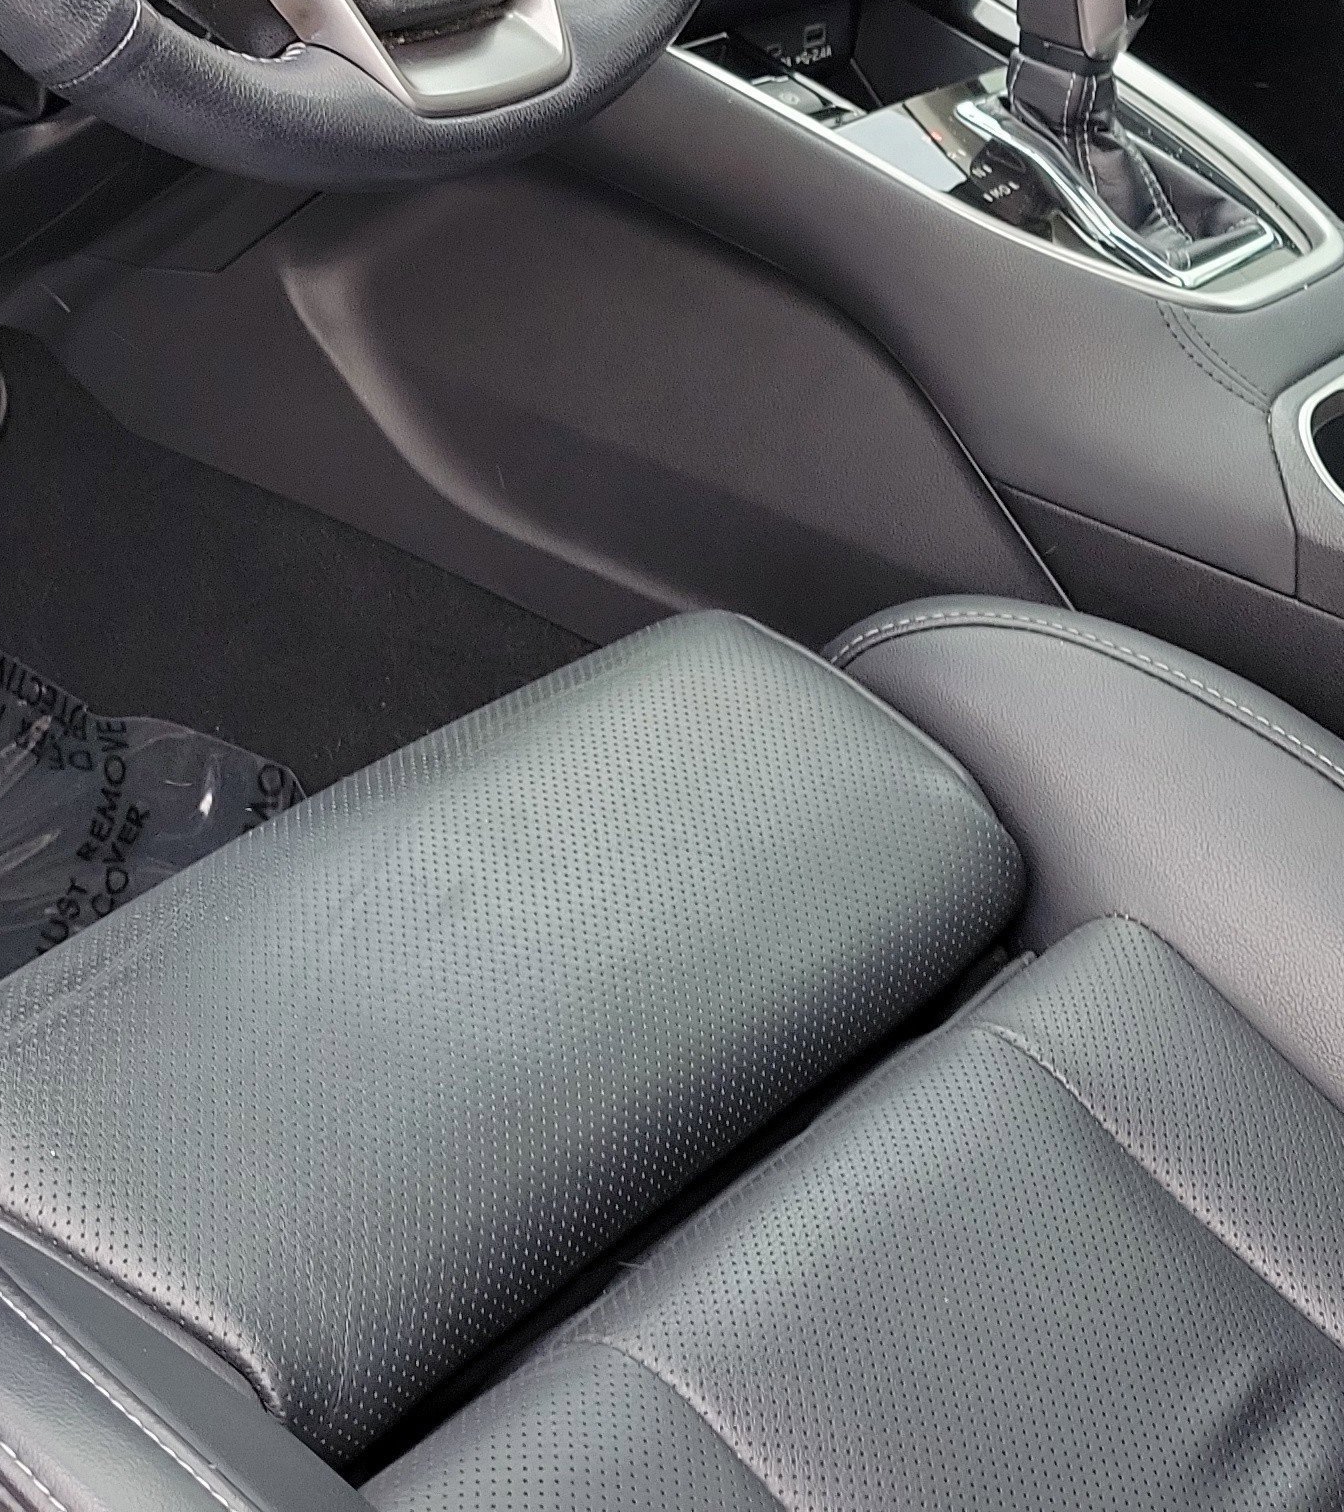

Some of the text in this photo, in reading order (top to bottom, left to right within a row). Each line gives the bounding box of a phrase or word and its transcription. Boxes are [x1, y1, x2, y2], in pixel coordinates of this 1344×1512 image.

[37, 720, 129, 954] UST REMOVE
[91, 805, 152, 918] COVER
